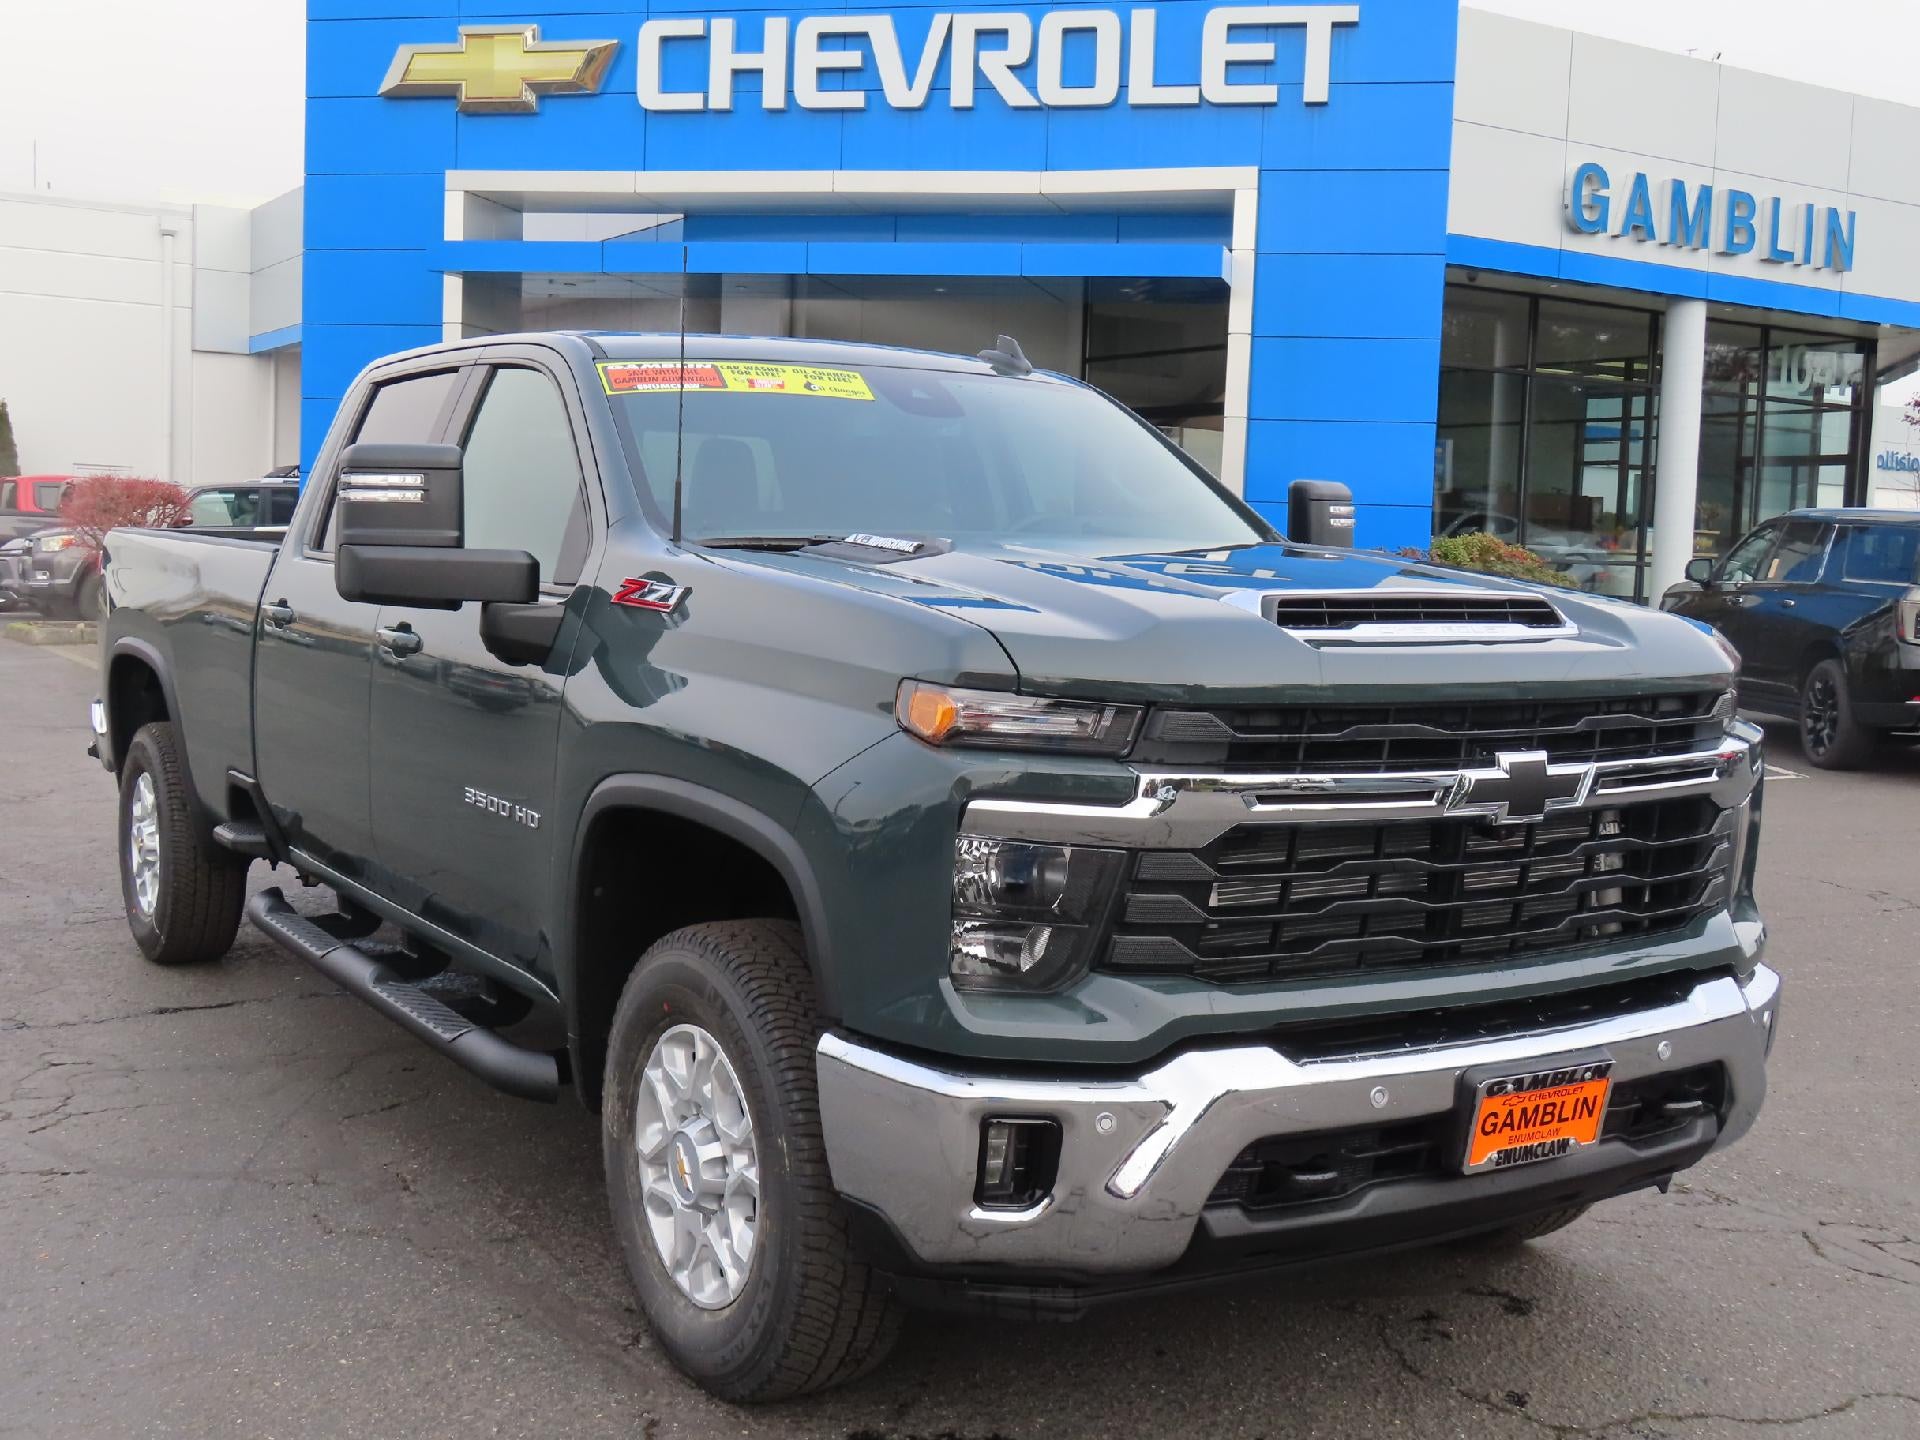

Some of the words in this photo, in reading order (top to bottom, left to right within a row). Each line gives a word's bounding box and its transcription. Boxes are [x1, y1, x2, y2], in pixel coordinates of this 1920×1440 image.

[637, 5, 1360, 111] CHEVROLET
[1563, 161, 1857, 273] GAMBLIN
[613, 376, 659, 385] GAMBLIN
[743, 365, 786, 373] WASHES
[812, 370, 859, 380] CHANGES
[611, 576, 692, 613] Z71
[464, 785, 509, 818] 3500
[515, 804, 541, 830] HD
[1527, 1086, 1585, 1102] CHEVROLET
[1480, 1095, 1597, 1136] GAMBLIN
[1508, 1127, 1561, 1145] ENUMCLAW
[1495, 1138, 1570, 1167] ENUMCLAW
